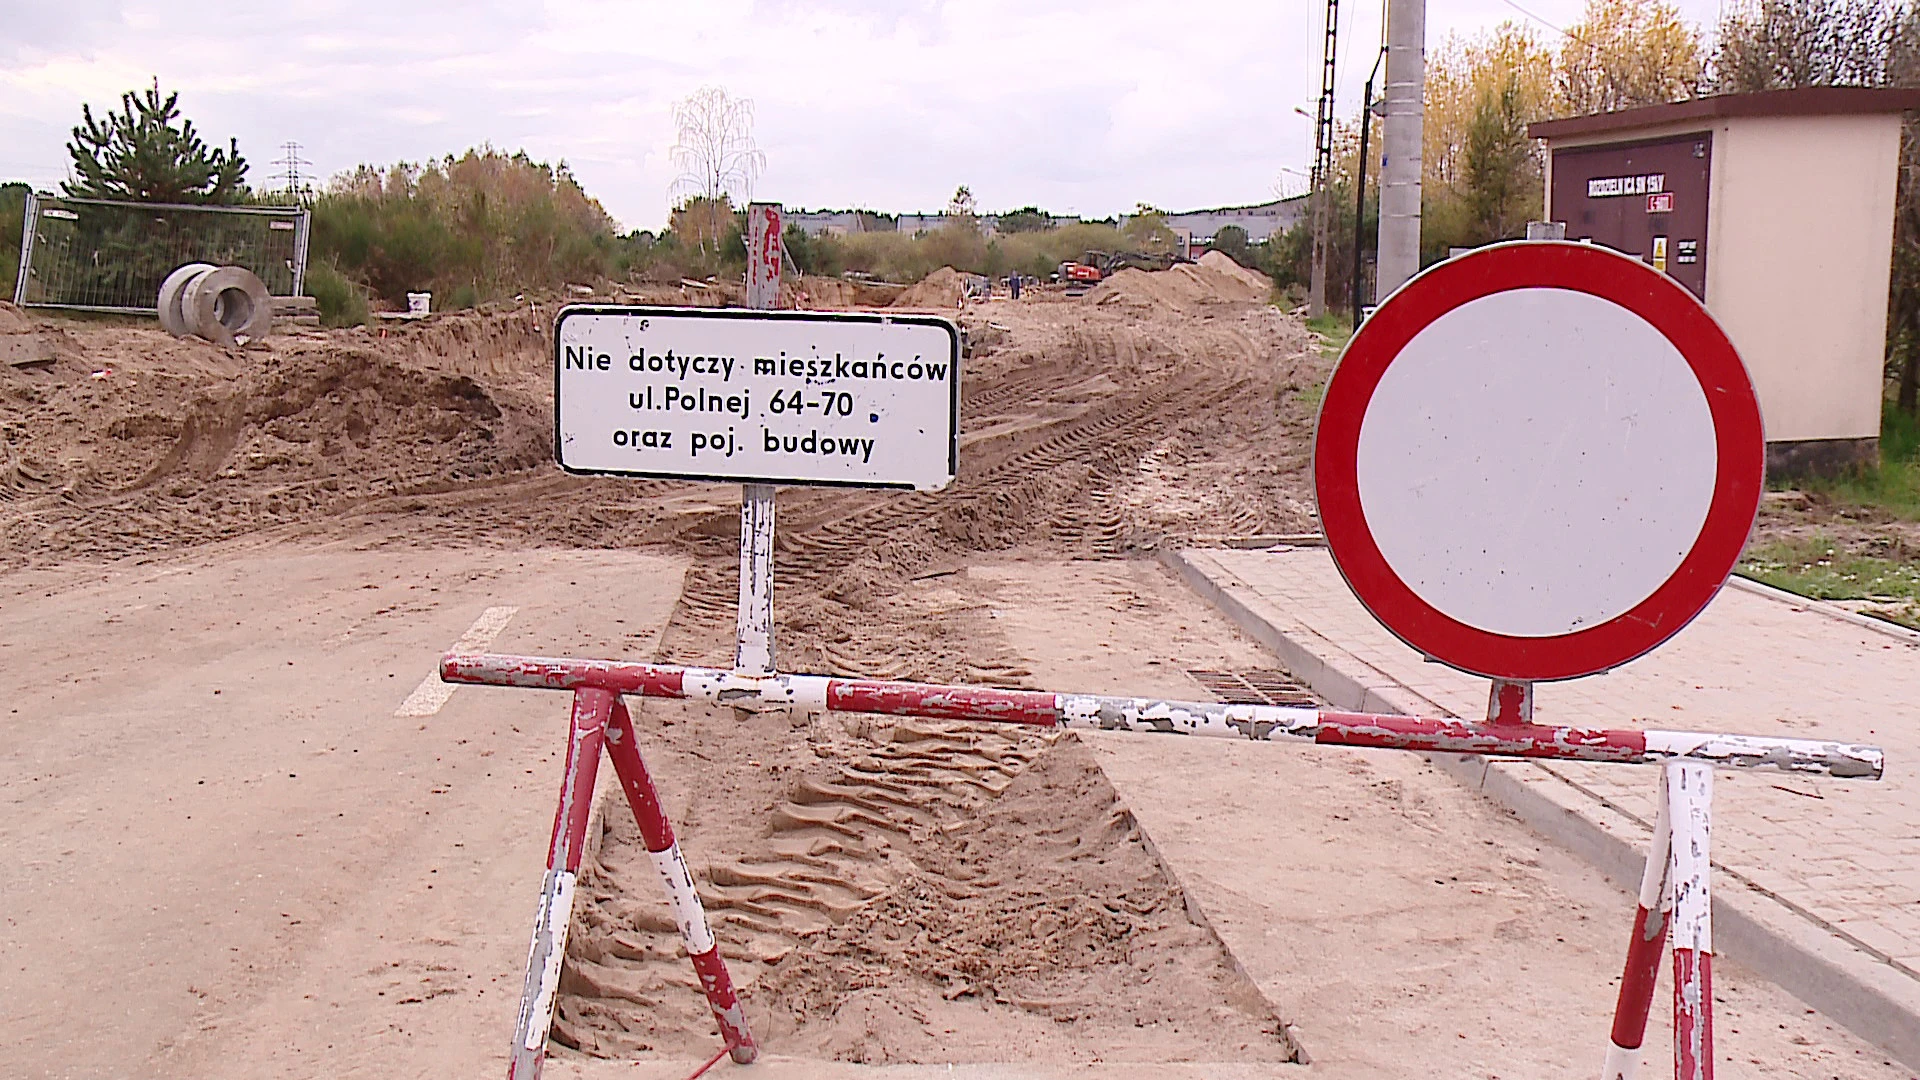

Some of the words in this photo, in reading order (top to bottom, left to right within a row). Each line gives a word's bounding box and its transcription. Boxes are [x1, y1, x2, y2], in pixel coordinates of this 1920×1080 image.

[565, 345, 611, 371] Nie
[628, 347, 735, 381] dotyczy
[754, 351, 948, 381] mieszkańców
[769, 388, 853, 416] 64-70
[613, 430, 672, 449] oraz
[691, 428, 744, 457] poj.
[763, 428, 875, 464] budowy
